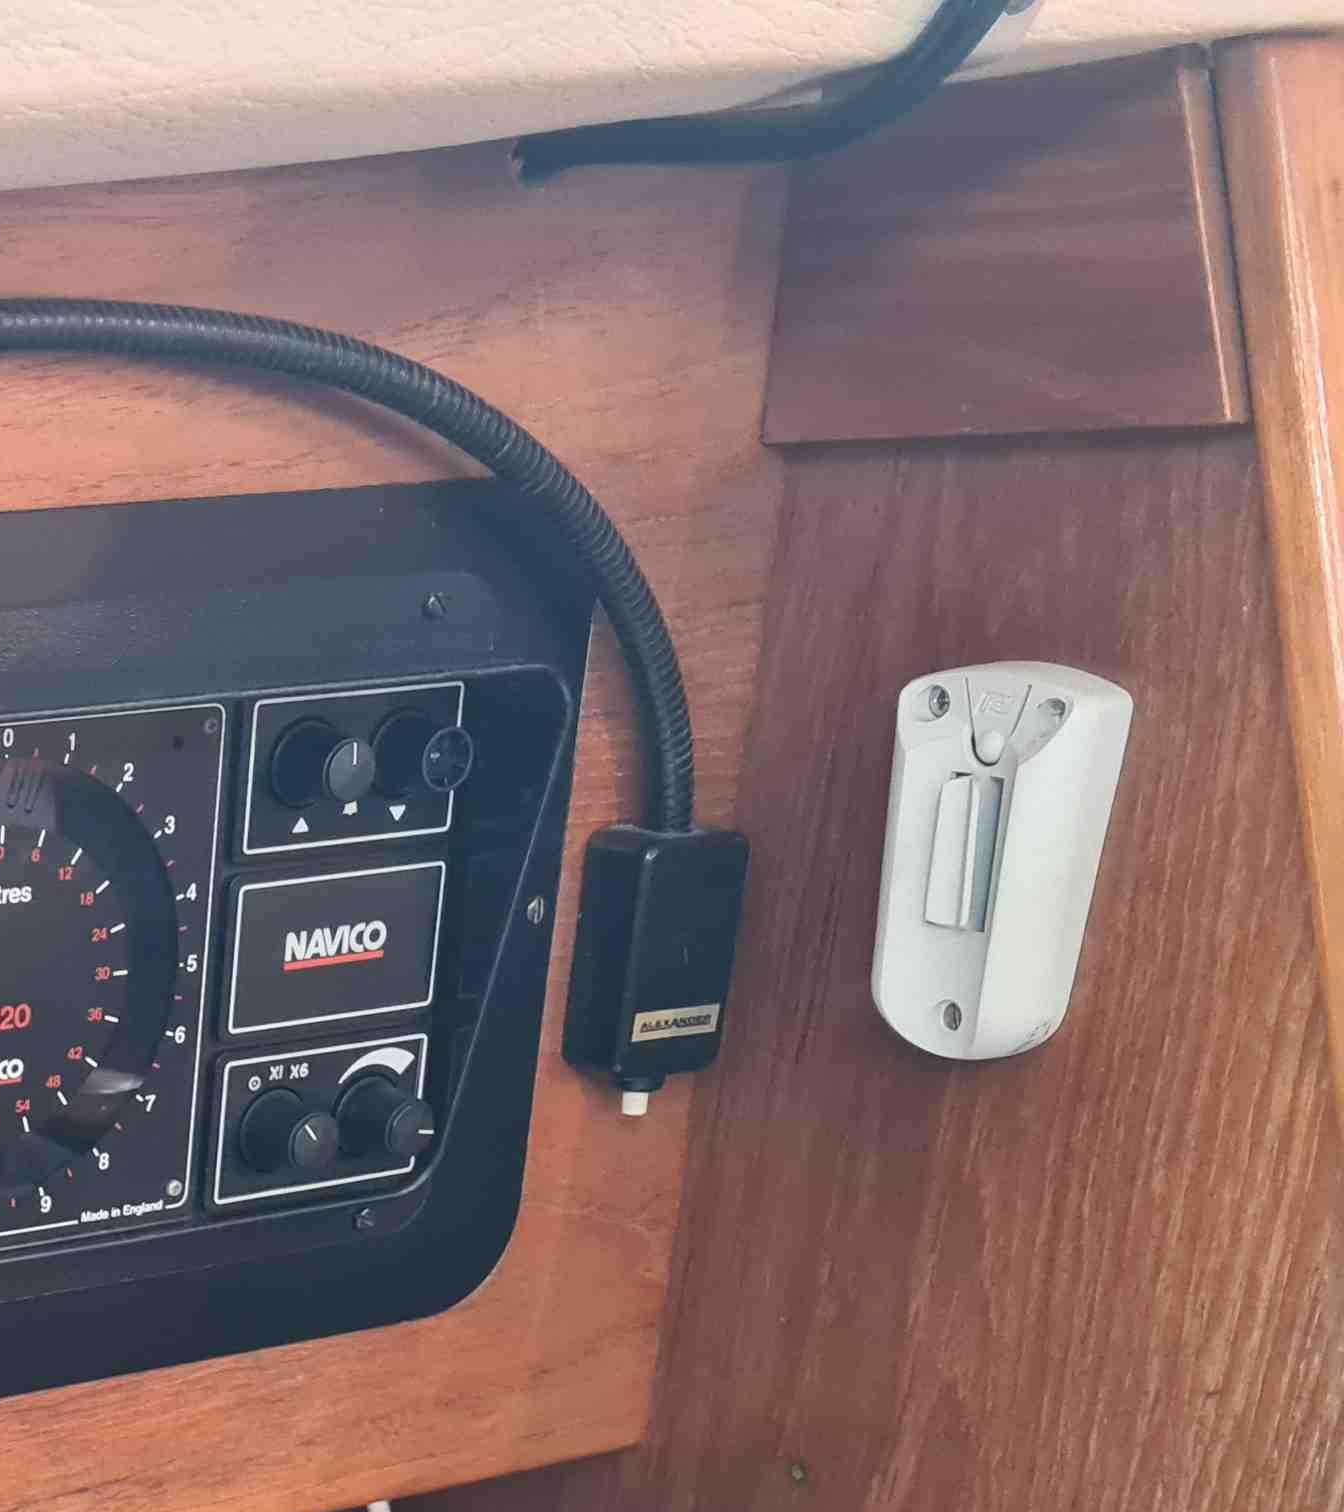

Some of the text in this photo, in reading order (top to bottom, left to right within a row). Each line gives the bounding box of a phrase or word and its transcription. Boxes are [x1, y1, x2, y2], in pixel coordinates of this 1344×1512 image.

[3, 729, 13, 747] 0
[68, 733, 76, 750] 1
[123, 764, 134, 781] 2
[164, 817, 175, 834] 3
[58, 866, 73, 880] 12
[186, 883, 197, 900] 4
[92, 928, 107, 941] 24
[284, 919, 387, 962] NAVICO
[186, 954, 197, 972] 5
[95, 967, 110, 980] 30
[174, 1026, 185, 1043] 6
[67, 1046, 82, 1060] 42
[145, 1094, 157, 1111] 7
[98, 1152, 109, 1169] 8
[40, 1195, 51, 1212] 9
[81, 1199, 164, 1223] Made in England
